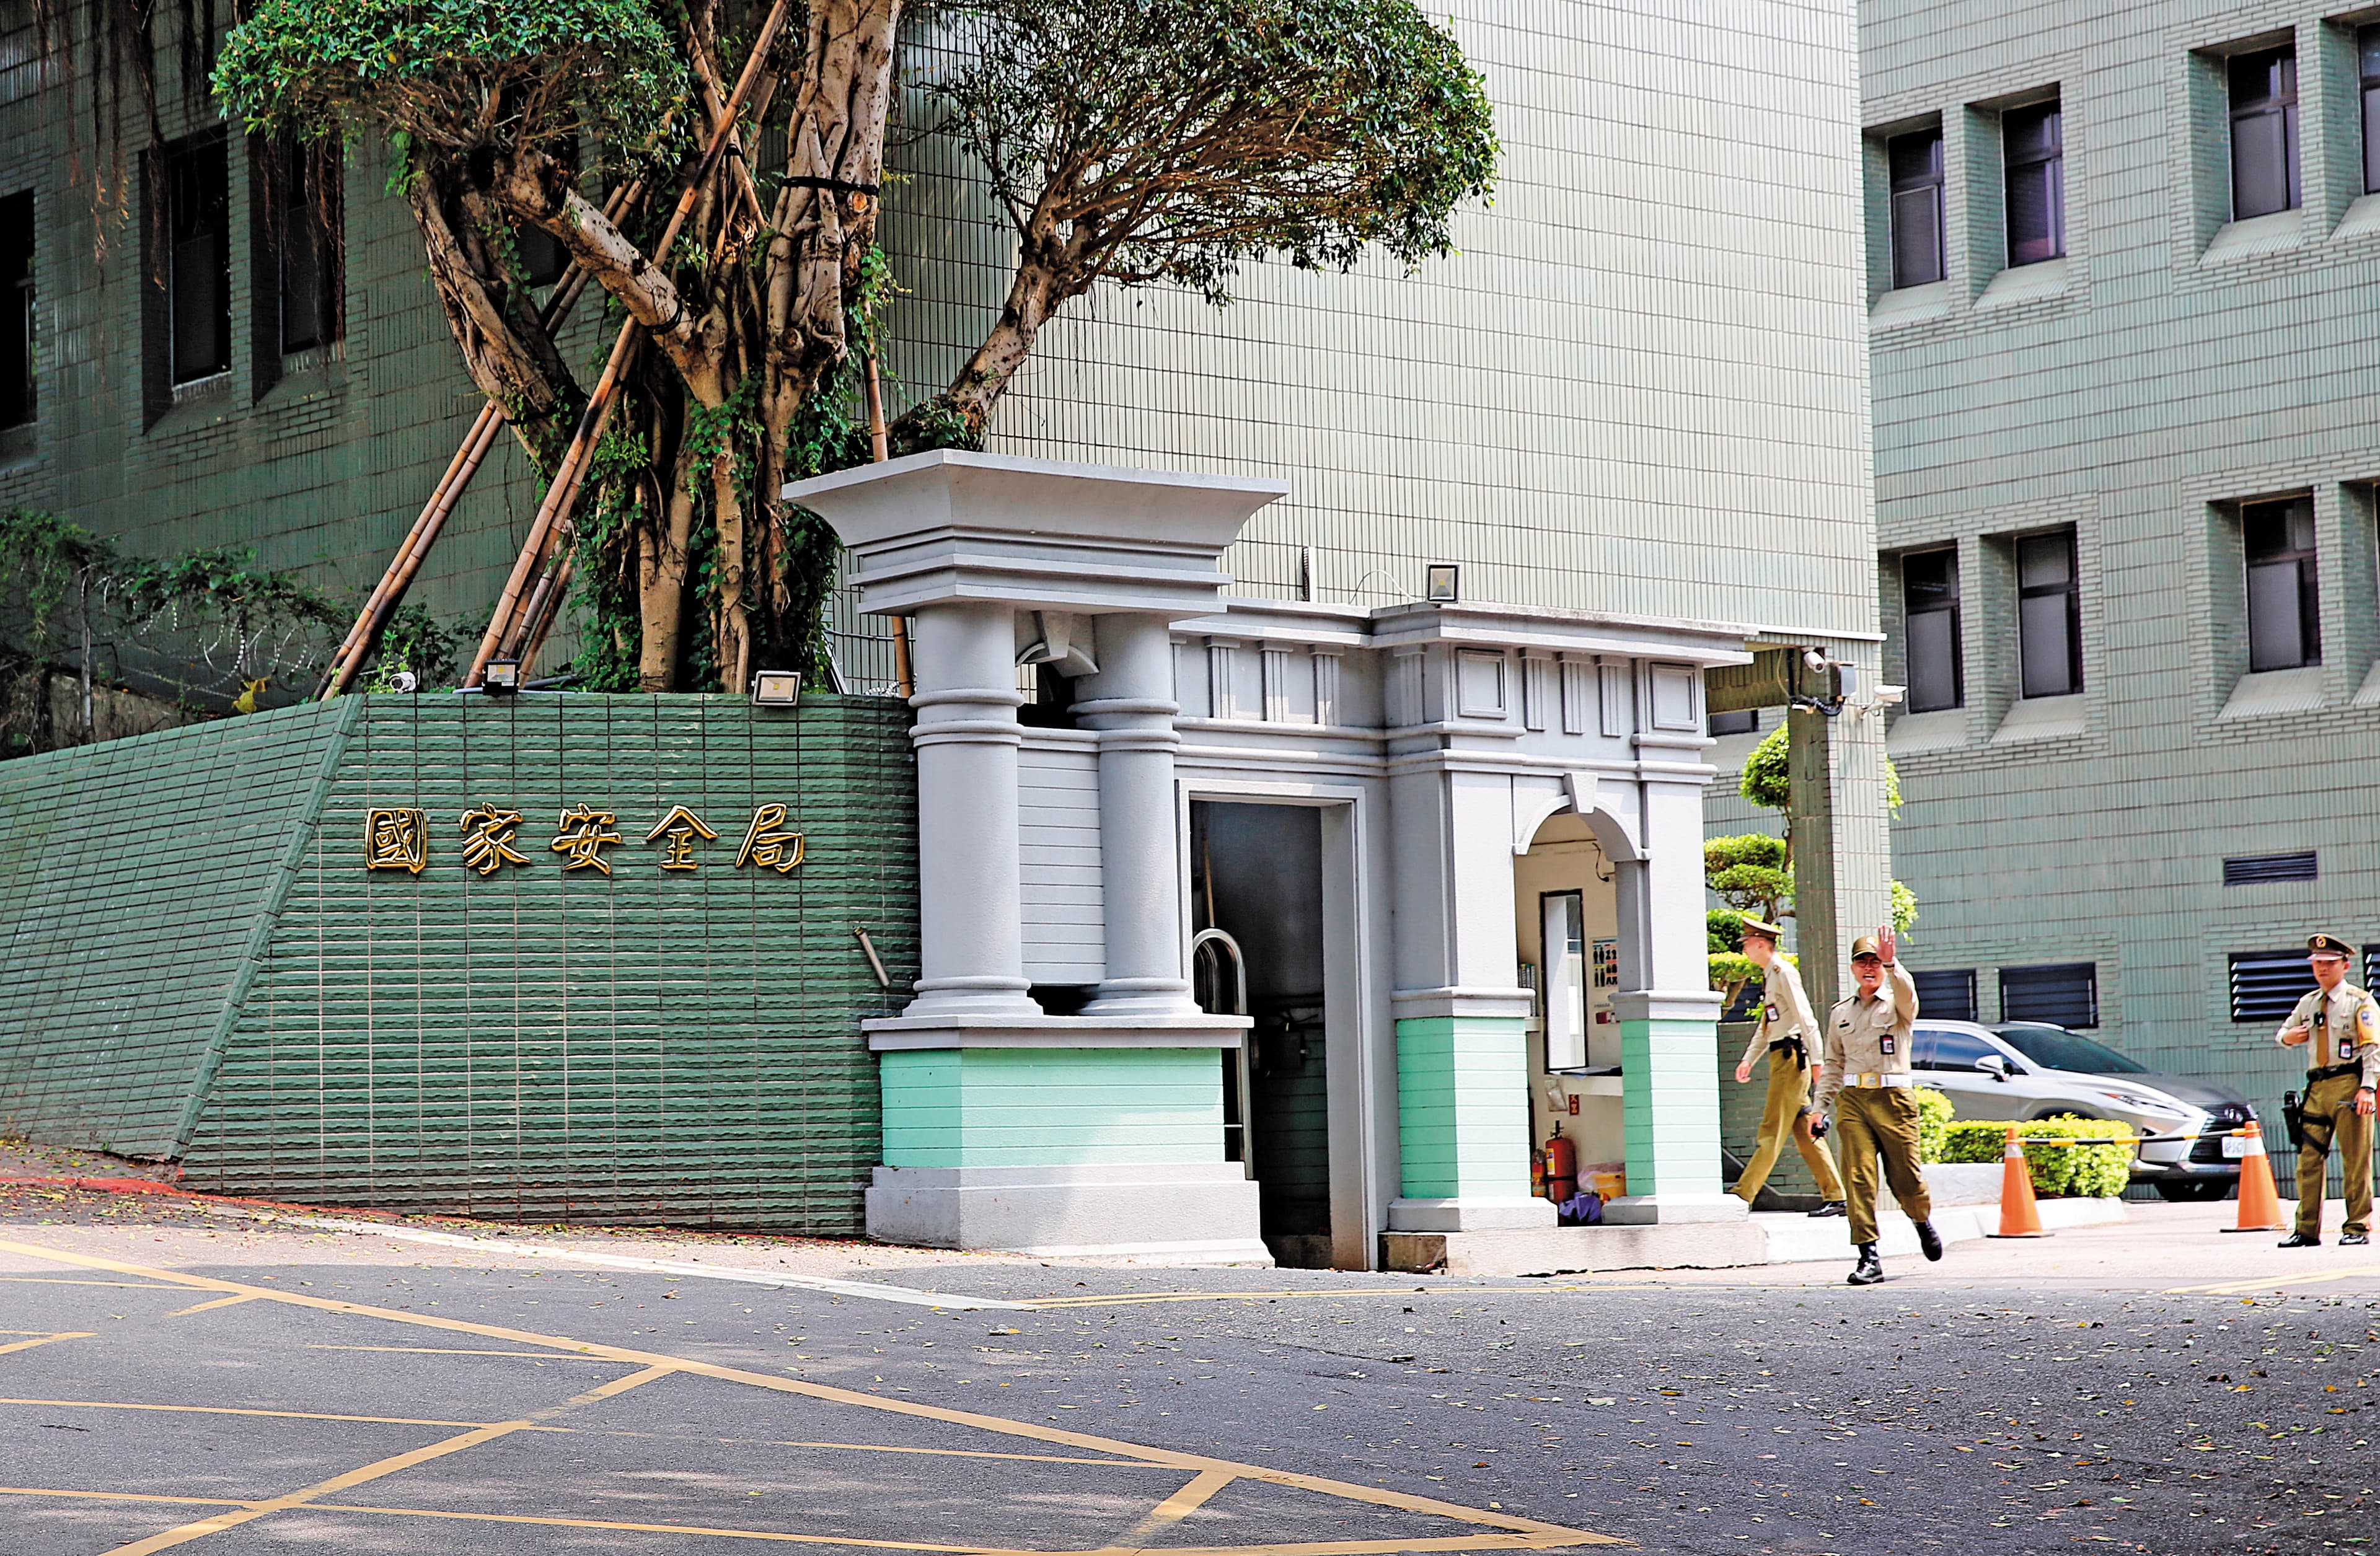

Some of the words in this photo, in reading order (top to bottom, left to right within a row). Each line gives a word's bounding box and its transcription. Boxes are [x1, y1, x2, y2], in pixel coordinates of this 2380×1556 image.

[364, 801, 805, 874] 國家安全局
